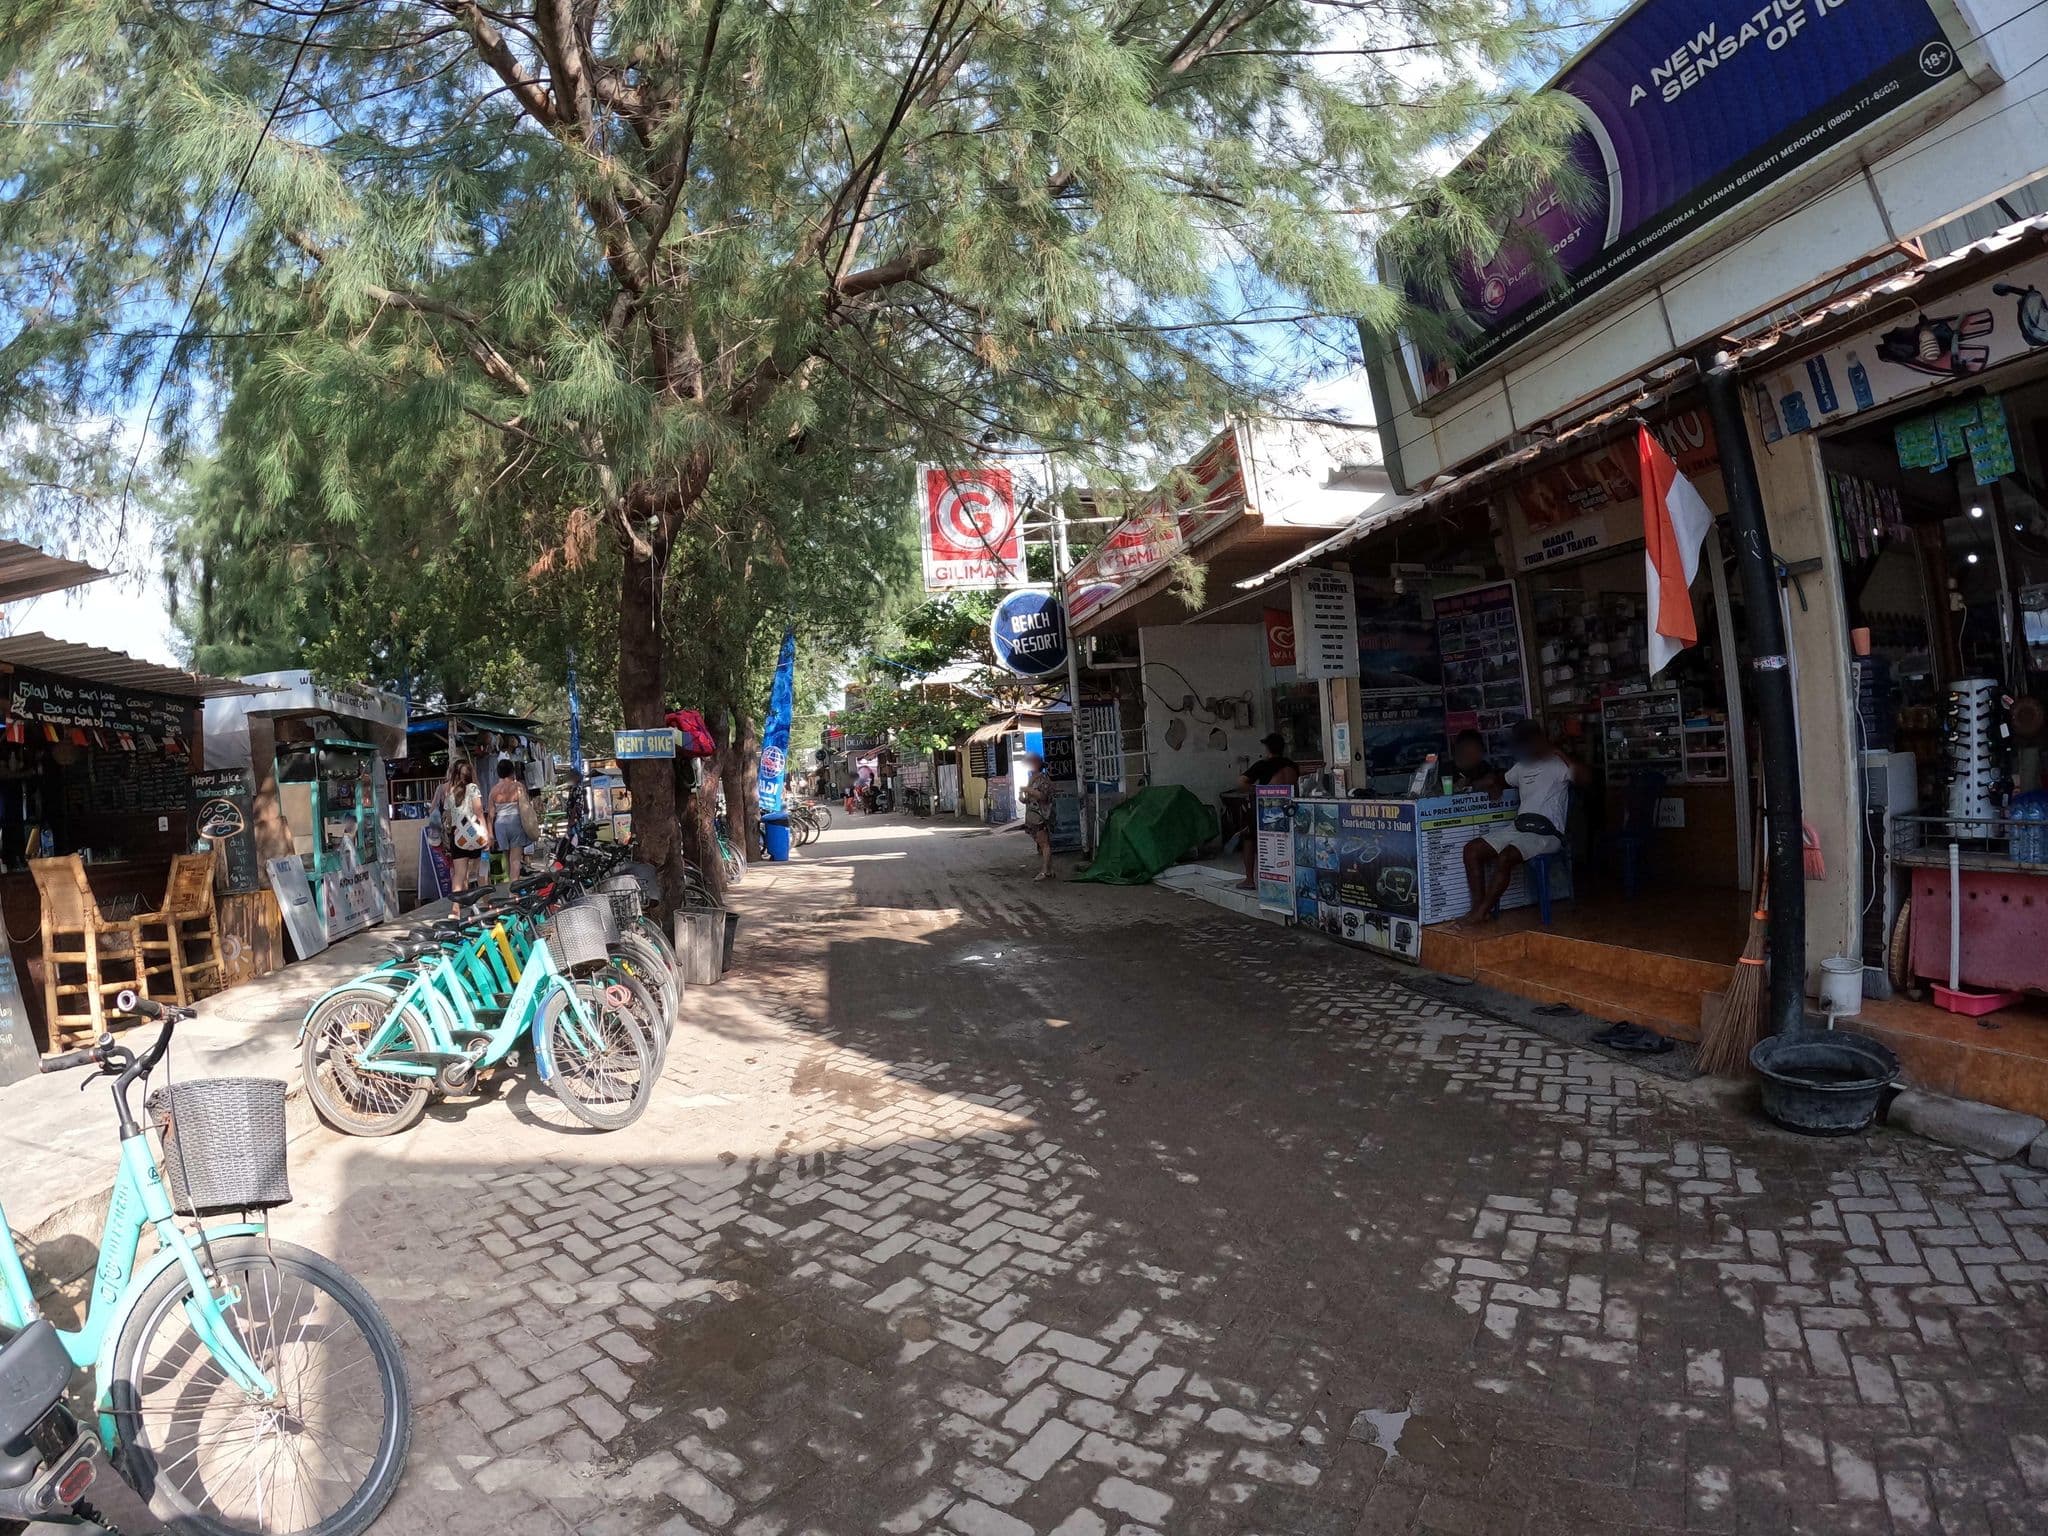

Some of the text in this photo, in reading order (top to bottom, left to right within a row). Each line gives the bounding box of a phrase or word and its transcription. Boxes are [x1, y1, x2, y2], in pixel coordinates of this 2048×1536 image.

[1766, 9, 1806, 50] OF
[1629, 22, 1716, 107] A NEW
[1558, 286, 1576, 301] SAYA
[1576, 267, 1607, 290] TERKENA
[1607, 246, 1637, 269] KANKER
[1637, 209, 1697, 249] TENGGOROKAN.
[1698, 182, 1735, 211] LAYANAN
[1735, 155, 1779, 187] BERHENTI
[1779, 126, 1827, 160] MEROKOK
[1524, 535, 1599, 566] TOUR AND TRAVEL
[1011, 612, 1050, 633] BEACH
[1013, 633, 1057, 655] RESORT
[617, 735, 673, 753] RENT BIKE
[1432, 807, 1452, 816] PRICE
[1453, 803, 1487, 814] INCLUDING
[1451, 795, 1479, 805] SHUTTLE
[1350, 804, 1400, 819] ONE DAY TRIP
[1387, 821, 1392, 830] 3
